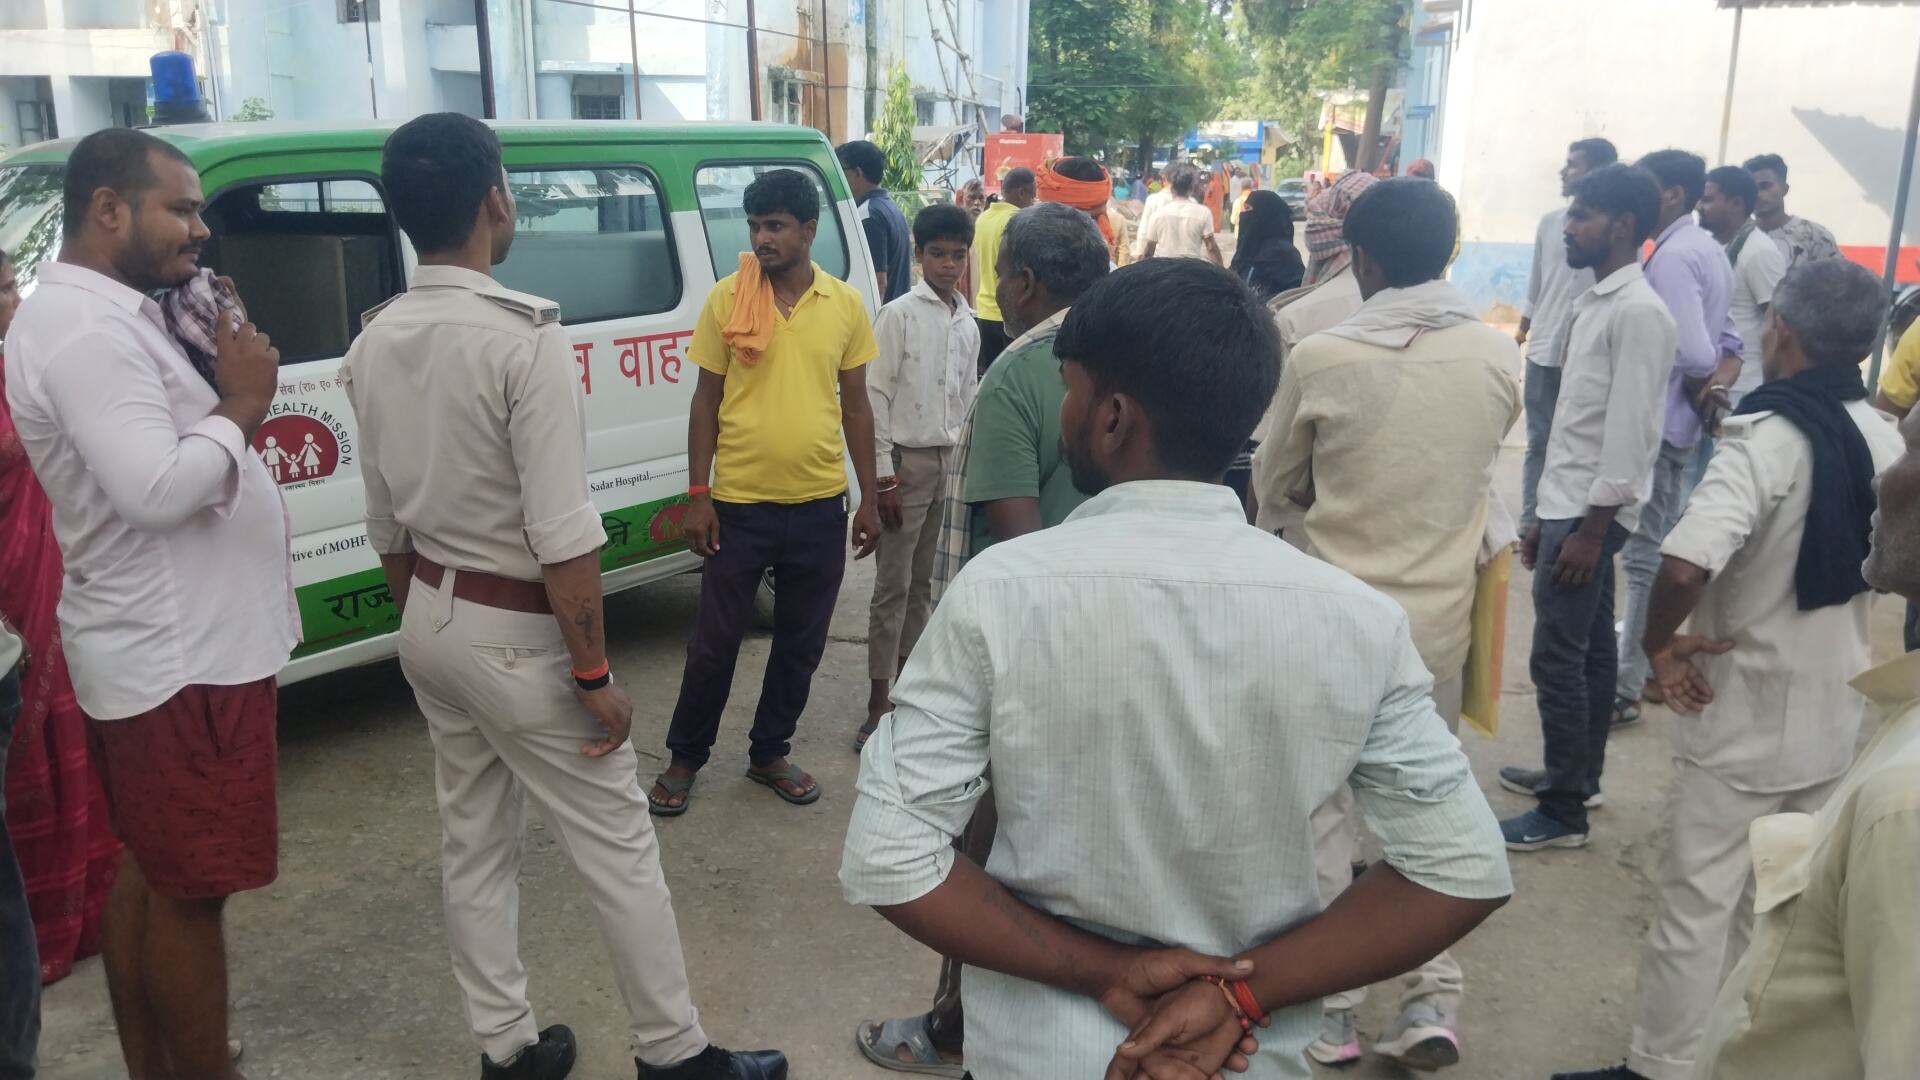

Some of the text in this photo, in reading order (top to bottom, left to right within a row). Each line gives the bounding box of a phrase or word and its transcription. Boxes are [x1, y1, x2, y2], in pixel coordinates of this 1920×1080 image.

[614, 330, 694, 387] वाह
[279, 383, 296, 396] सेवा
[320, 411, 352, 465] MISSION
[590, 481, 614, 493] Sadar
[315, 543, 328, 557] of
